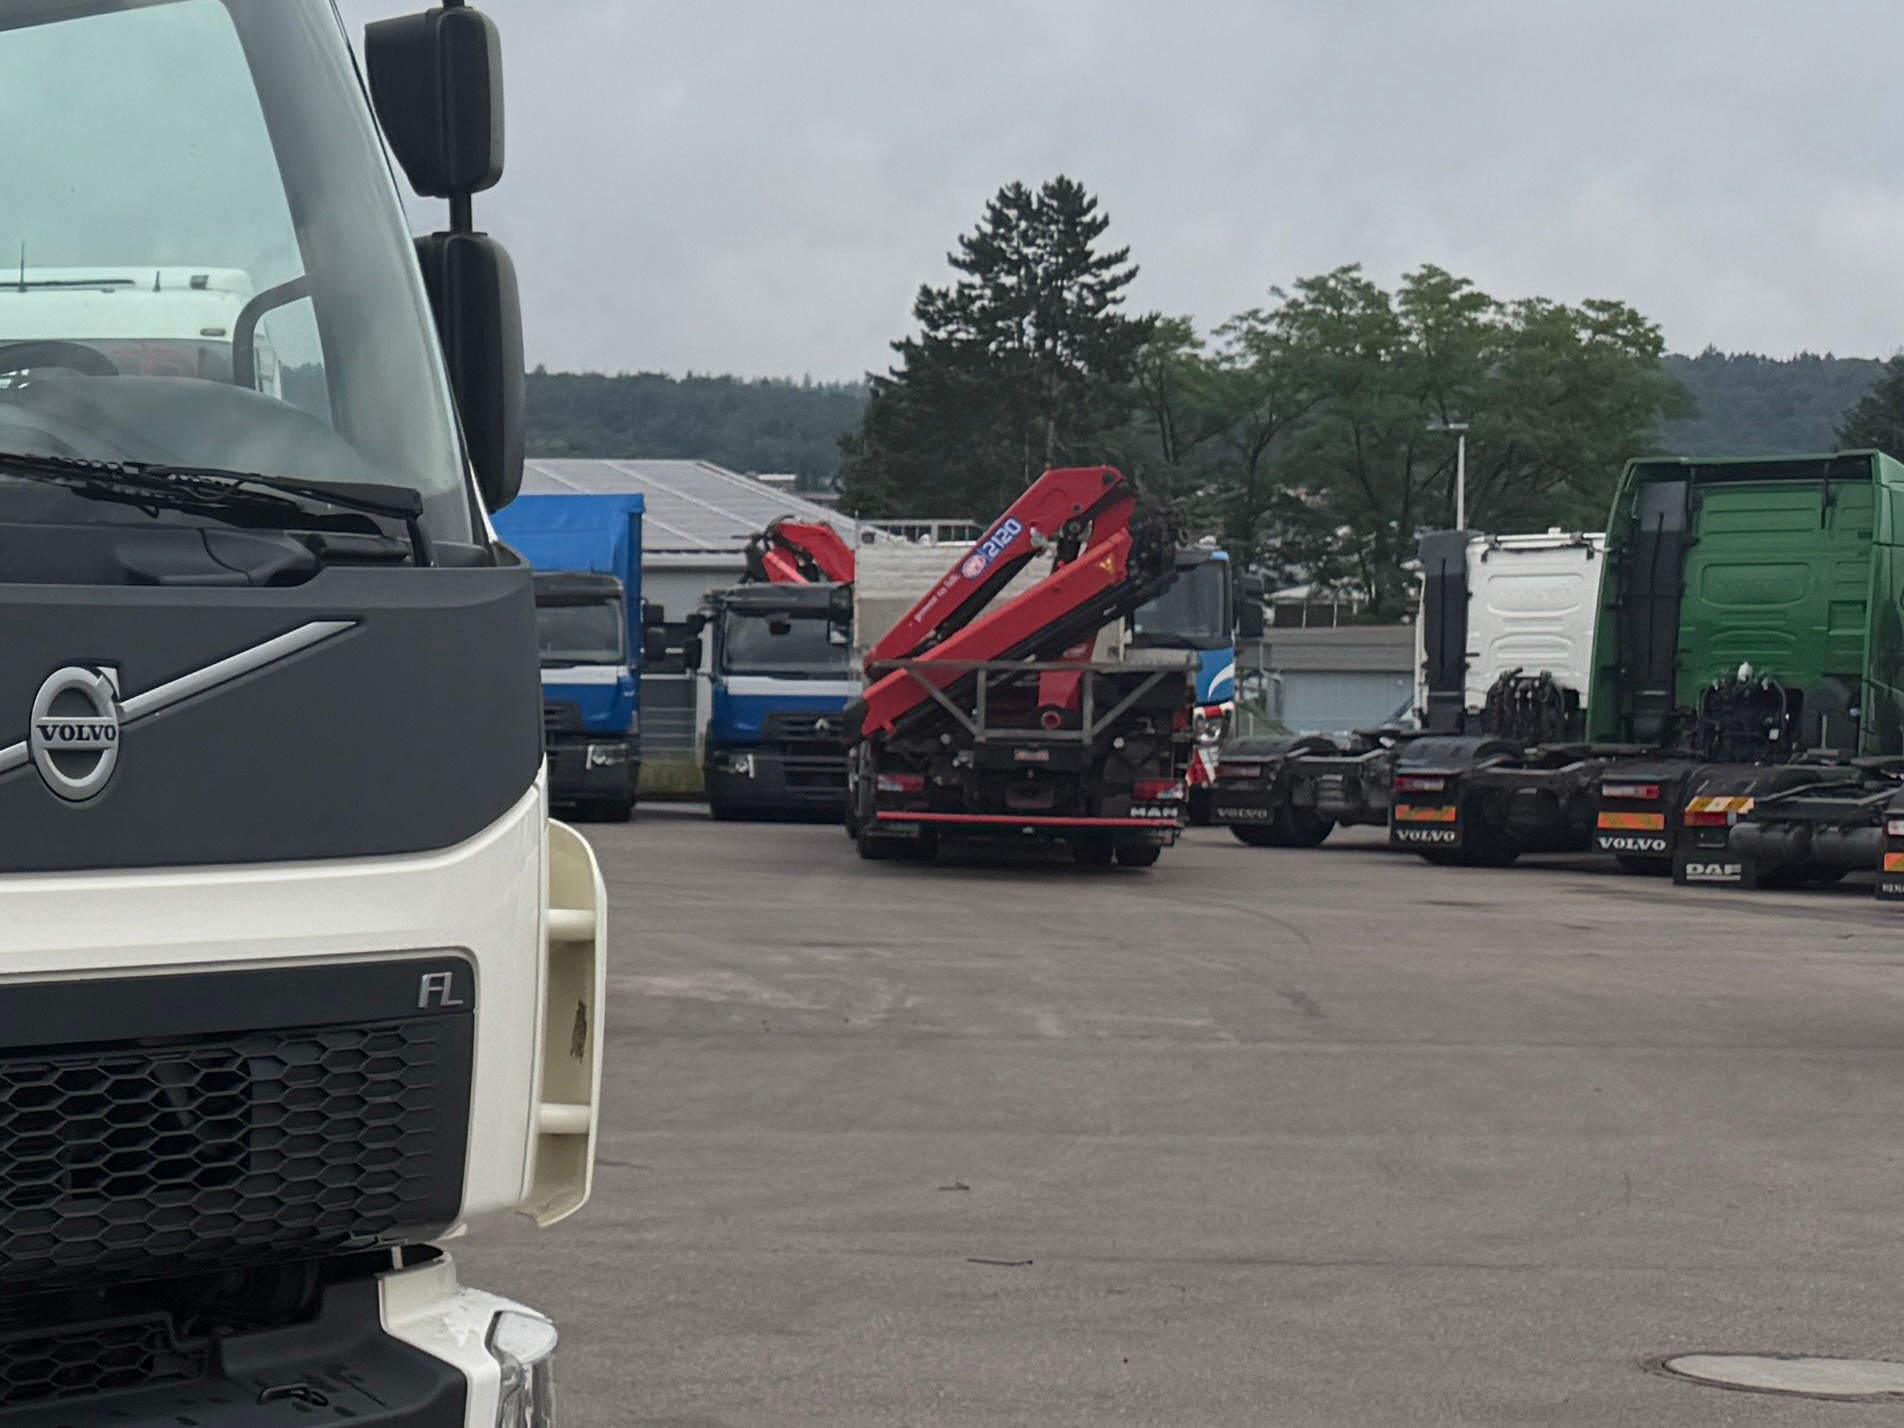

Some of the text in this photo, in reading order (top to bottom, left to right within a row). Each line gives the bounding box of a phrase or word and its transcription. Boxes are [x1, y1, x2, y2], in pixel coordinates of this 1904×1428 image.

[982, 518, 1023, 558] 2120
[36, 724, 117, 741] VOLVO
[1217, 808, 1268, 818] VOLVO
[1396, 829, 1456, 842] VOLVO
[1597, 836, 1667, 852] VOLVO
[1686, 863, 1742, 876] DAF
[418, 972, 464, 1008] FL
